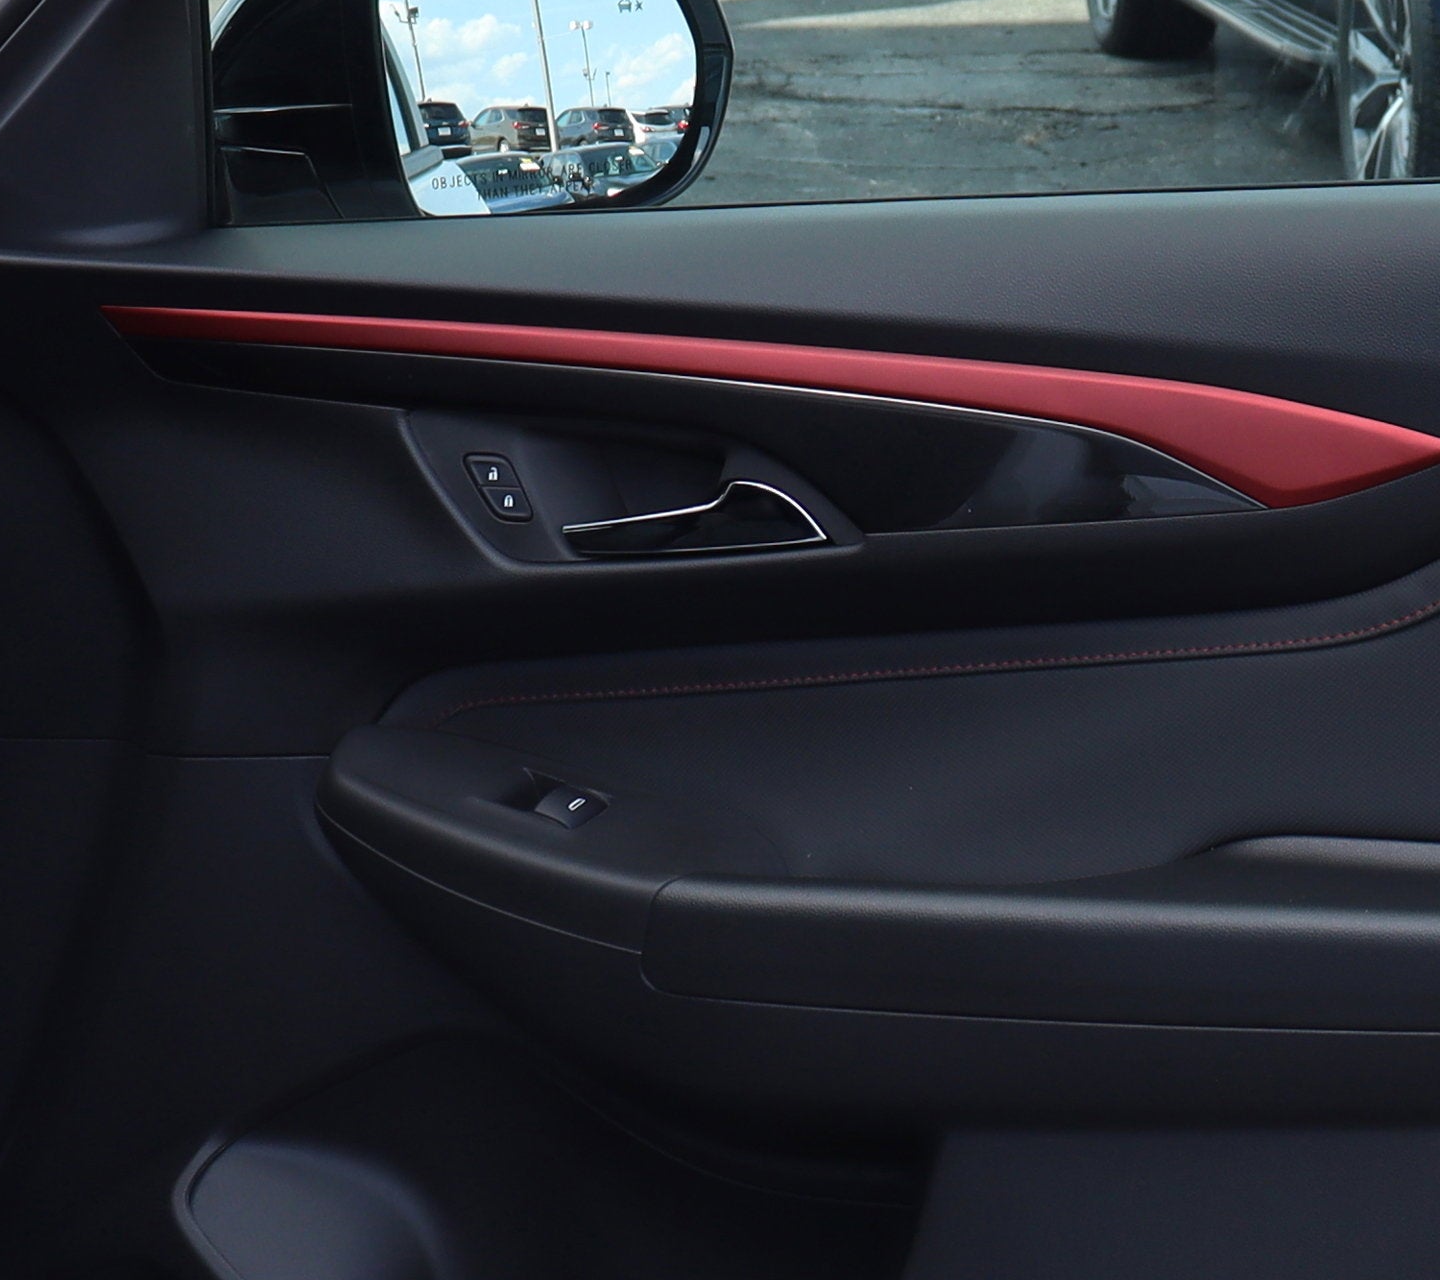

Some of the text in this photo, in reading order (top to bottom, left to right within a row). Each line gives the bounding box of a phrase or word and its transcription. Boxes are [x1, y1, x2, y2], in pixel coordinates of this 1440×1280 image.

[431, 158, 633, 190] OBJECTS IN MIRROR ARE CLOSER
[478, 179, 596, 200] THAN THEY APPEAR
